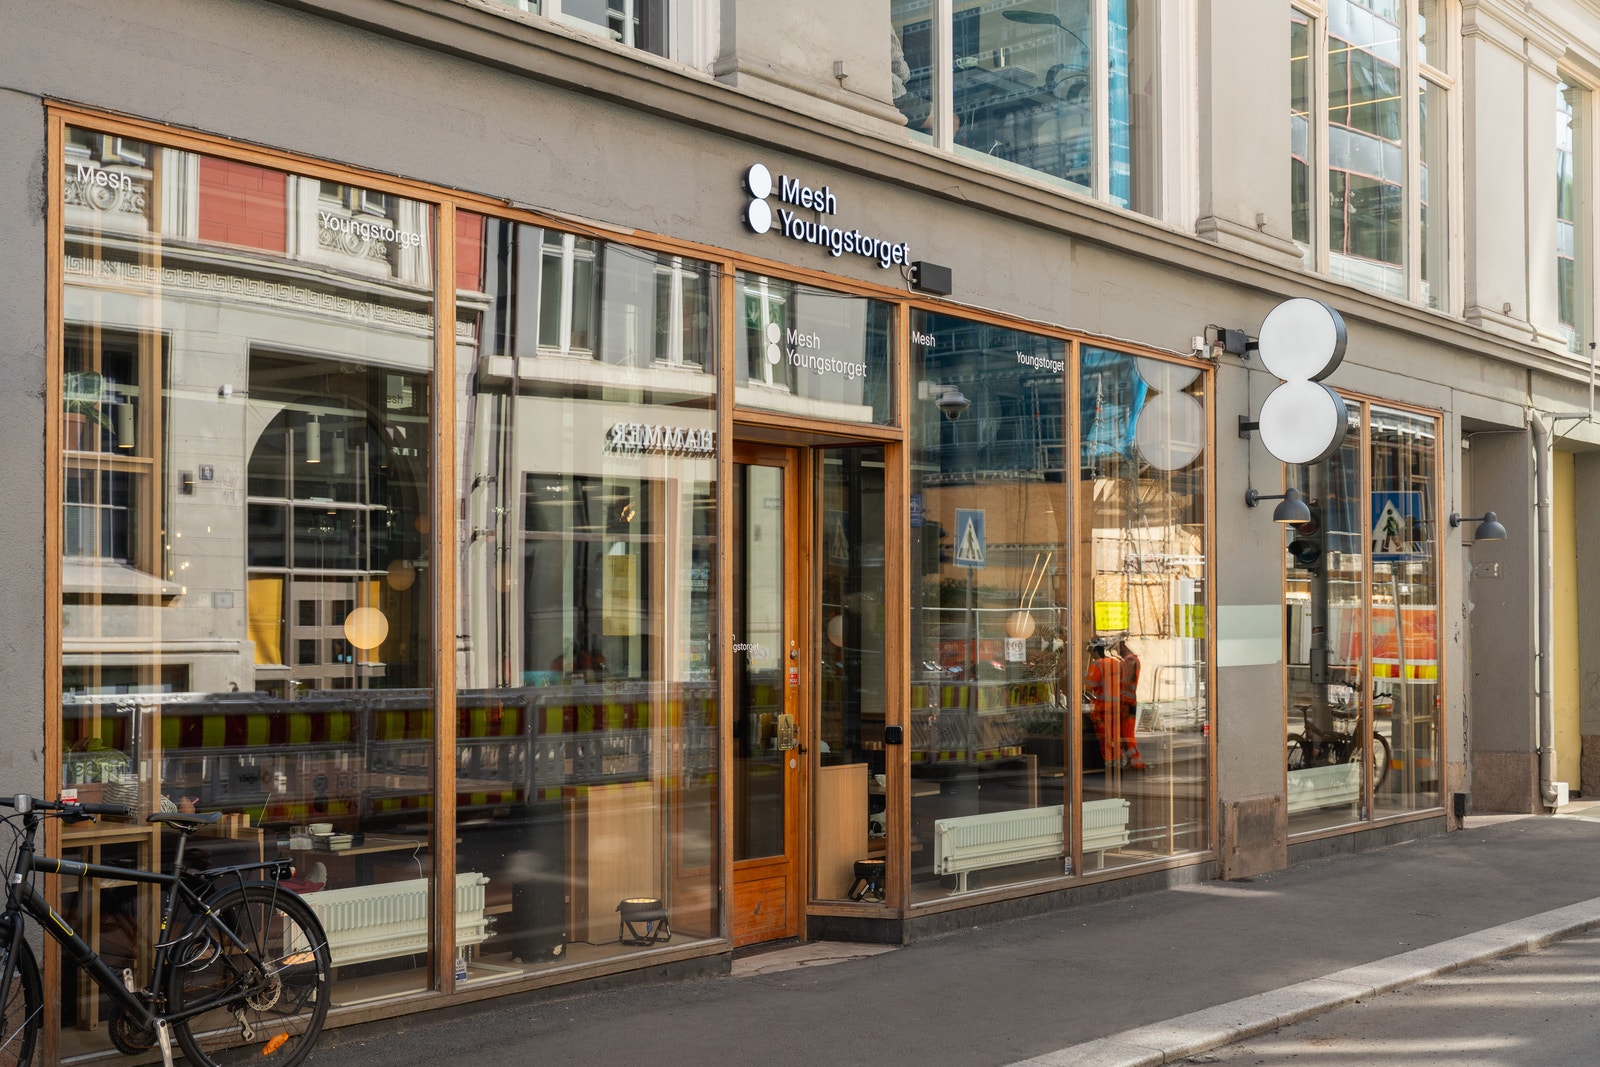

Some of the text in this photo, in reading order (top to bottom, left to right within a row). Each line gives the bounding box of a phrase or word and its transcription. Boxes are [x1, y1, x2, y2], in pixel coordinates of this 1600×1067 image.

[77, 163, 132, 191] Mesh
[780, 174, 837, 215] Mesh
[320, 211, 425, 248] Youngstorget
[778, 208, 910, 269] Youngstorget
[786, 327, 820, 349] Mesh
[912, 331, 936, 347] Mesh
[786, 347, 867, 380] Youngstorget
[1016, 351, 1065, 373] Youngstorget
